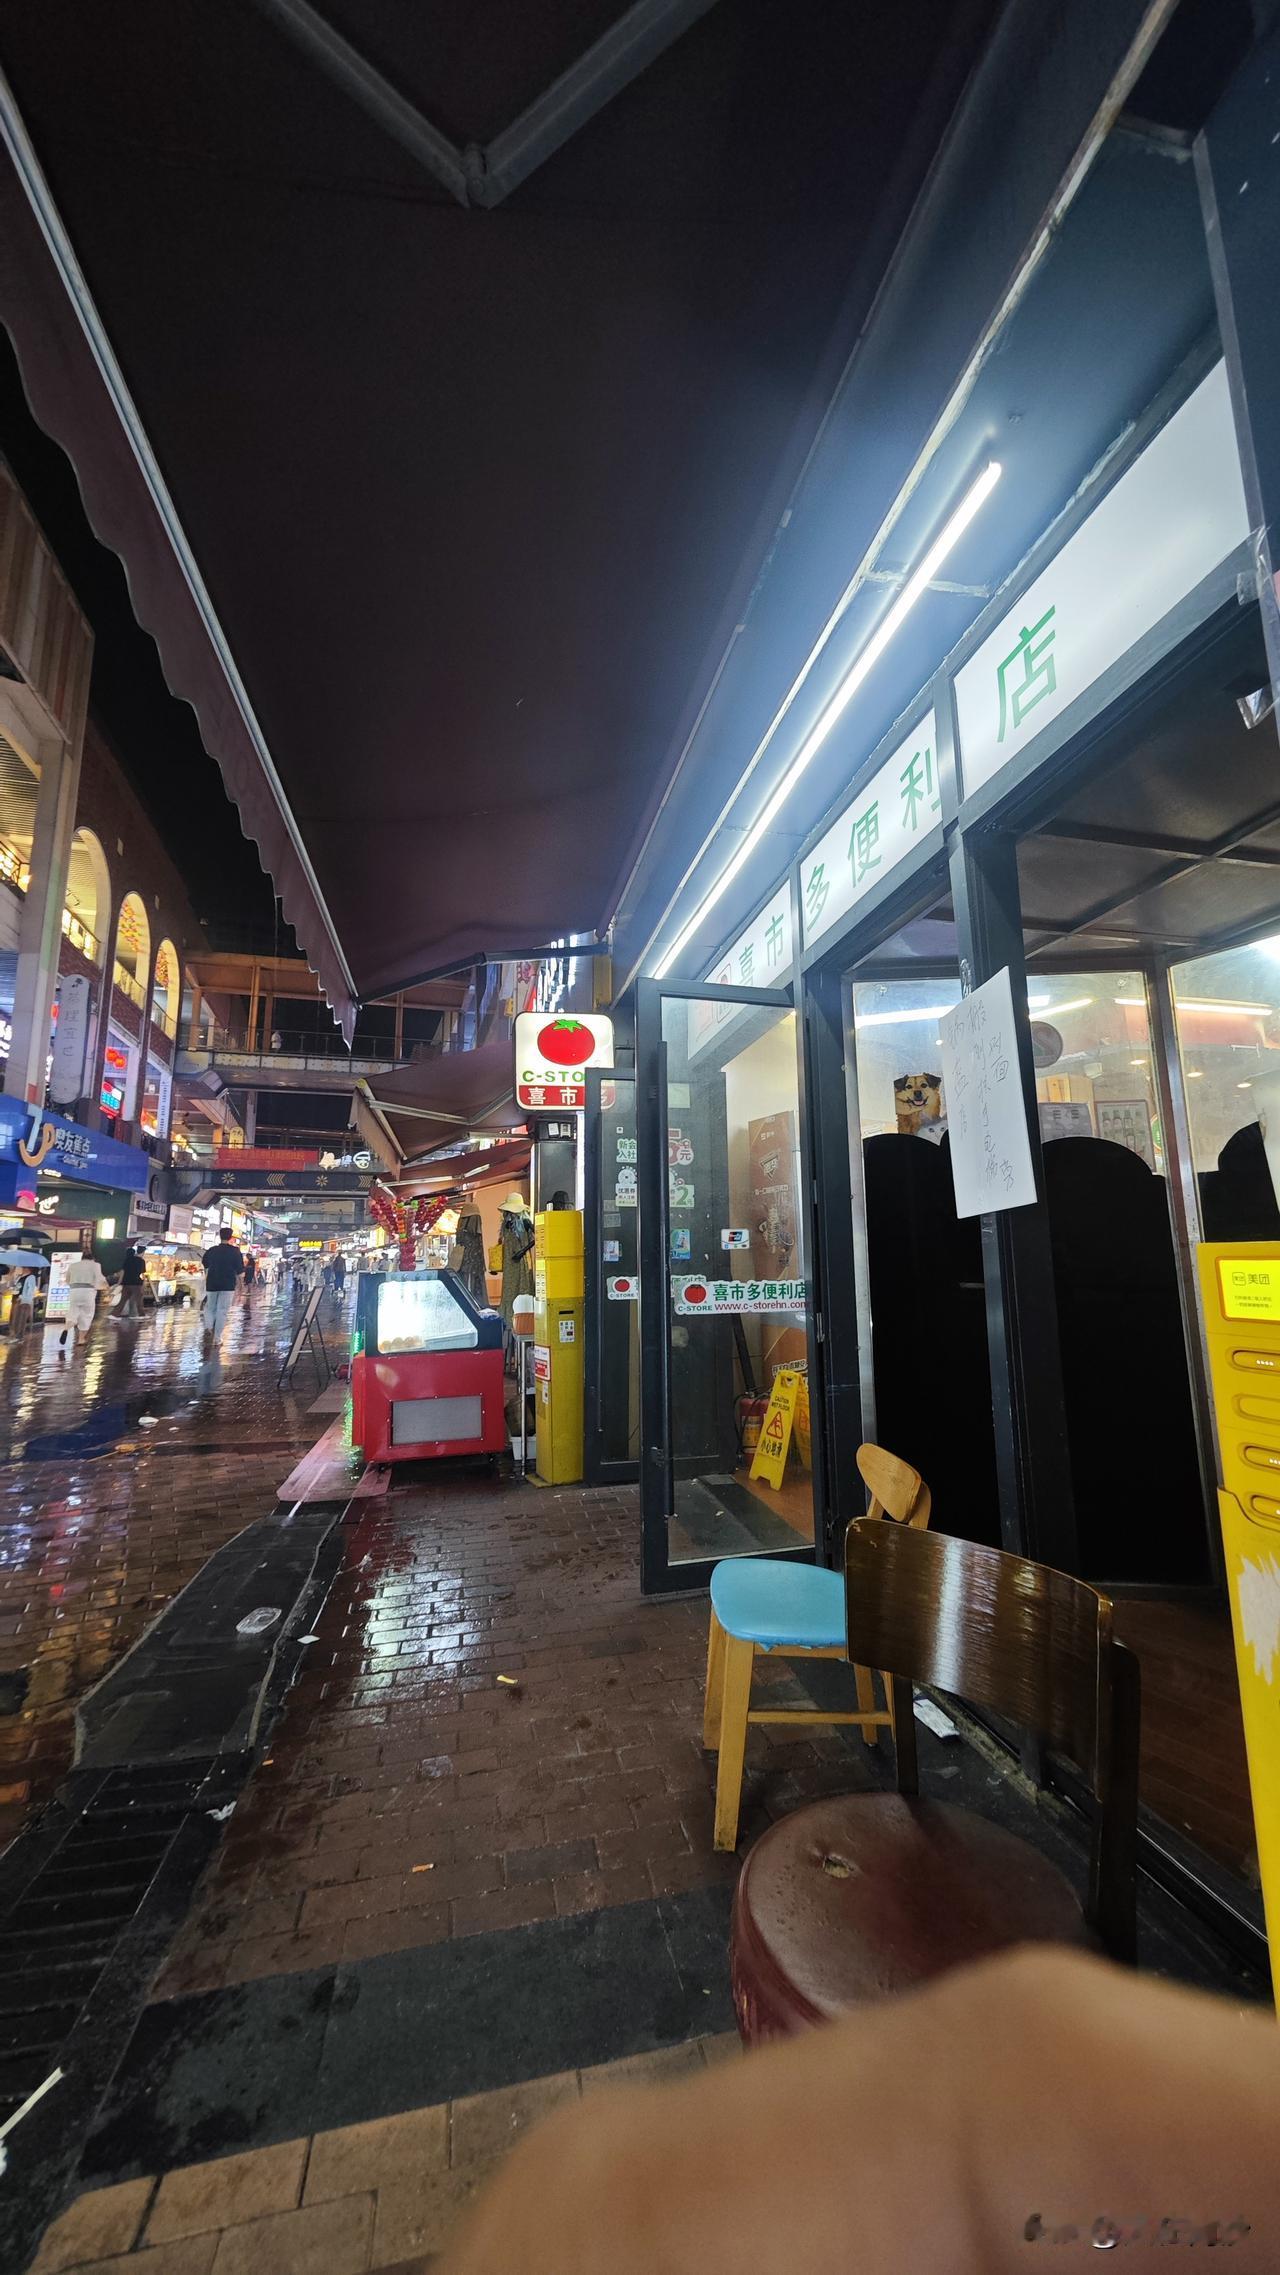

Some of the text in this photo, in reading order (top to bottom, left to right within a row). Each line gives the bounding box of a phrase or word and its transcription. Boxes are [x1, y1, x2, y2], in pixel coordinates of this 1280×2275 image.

[522, 1070, 585, 1083] C-STO
[1247, 1273, 1271, 1285] 美团
[712, 1282, 807, 1301] 喜市多便利店
[678, 1304, 713, 1312] C-STORE
